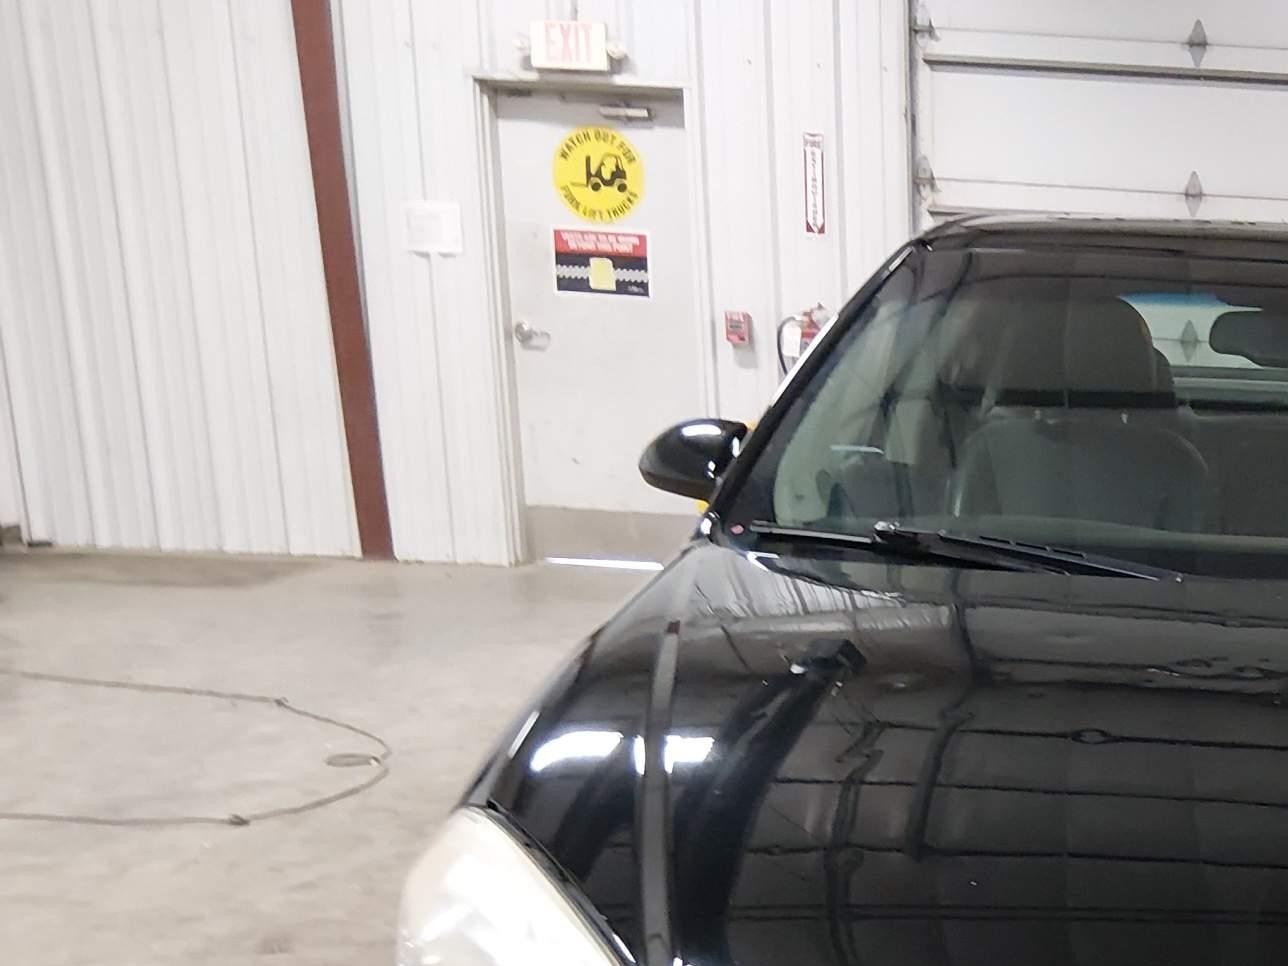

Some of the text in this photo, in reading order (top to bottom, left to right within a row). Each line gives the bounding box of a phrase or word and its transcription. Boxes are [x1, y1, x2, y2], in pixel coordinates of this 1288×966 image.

[544, 22, 592, 64] EXIT
[560, 129, 592, 161] WATCH
[594, 129, 617, 145] OUT
[606, 191, 639, 220] TRUCKS
